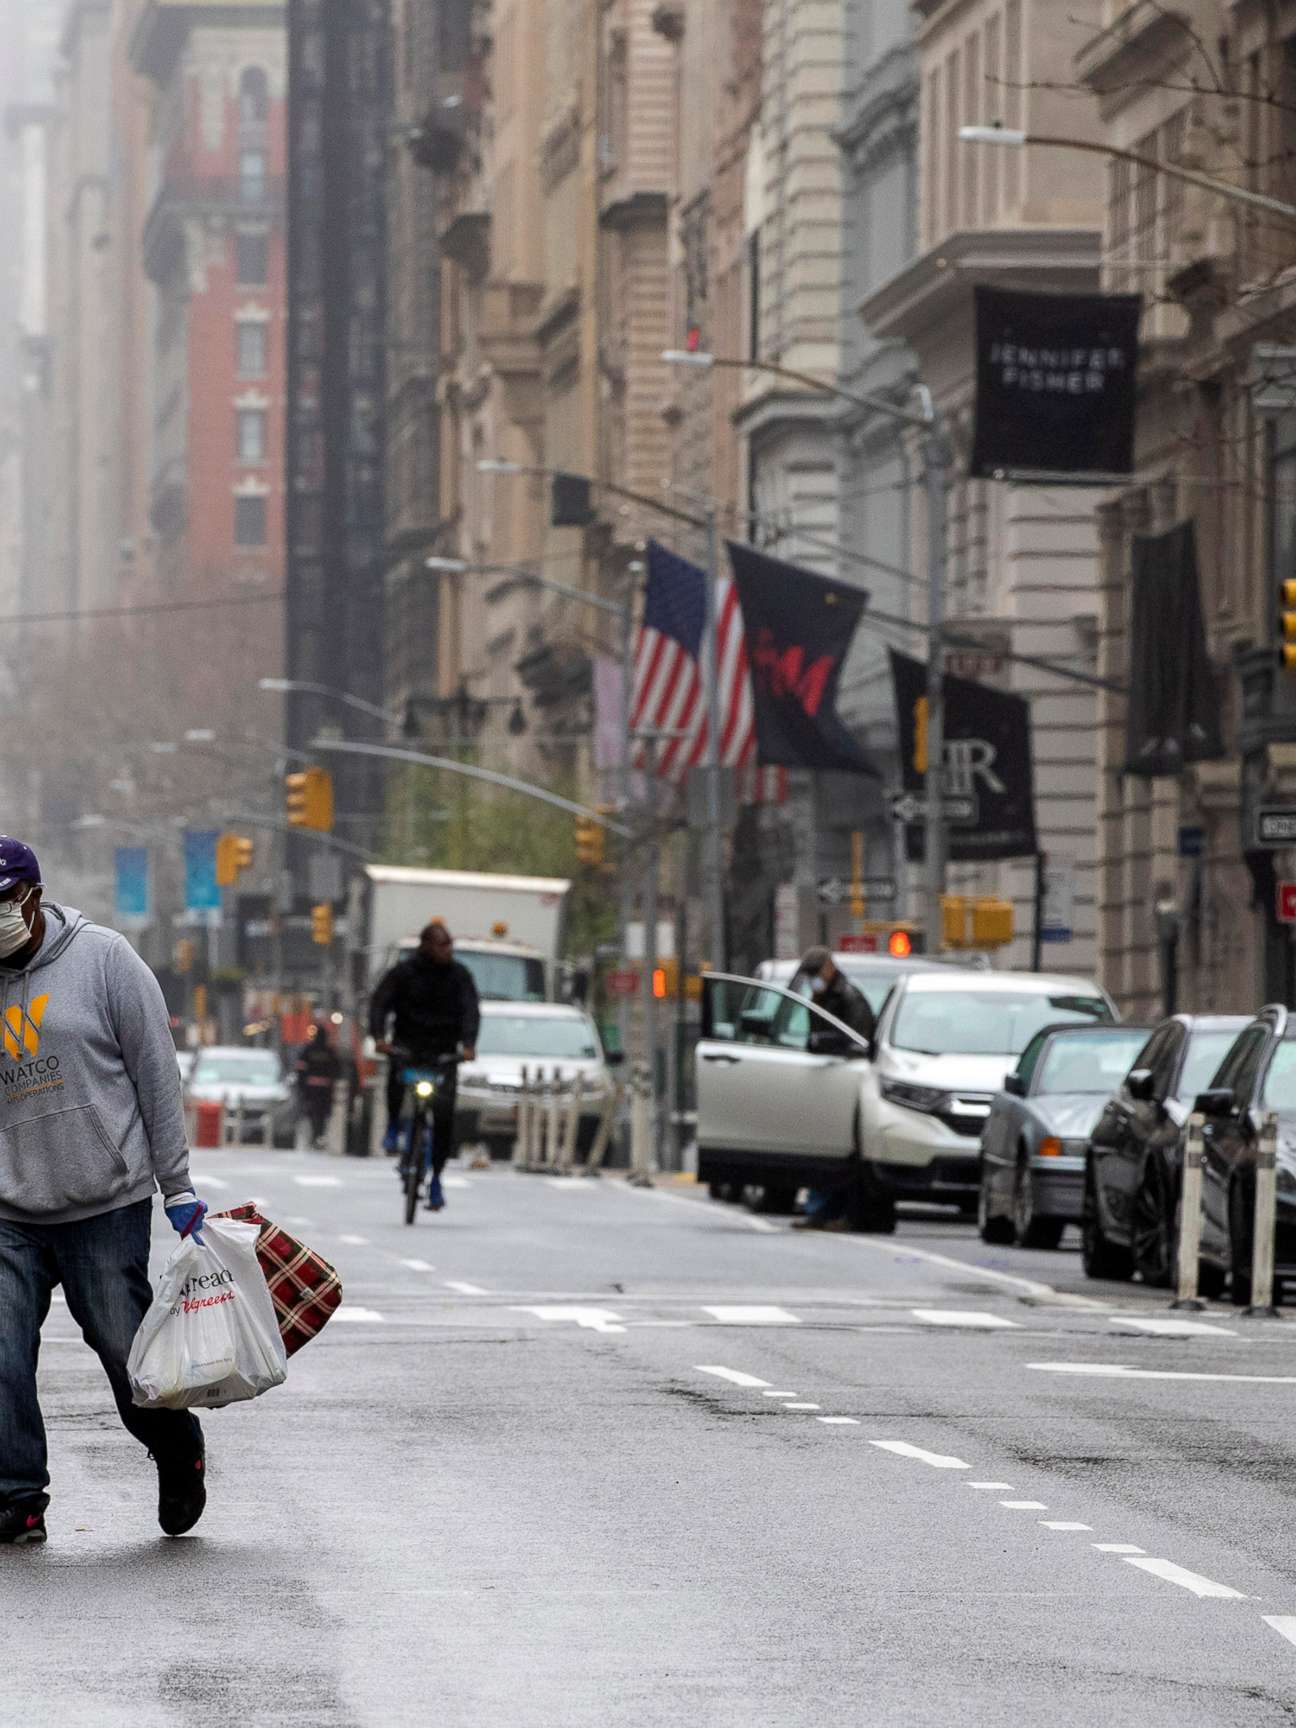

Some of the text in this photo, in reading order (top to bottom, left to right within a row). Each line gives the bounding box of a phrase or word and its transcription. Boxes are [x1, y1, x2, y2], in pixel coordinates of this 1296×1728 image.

[1003, 366, 1104, 394] FISHER
[0, 1055, 60, 1085] WATCO
[5, 1071, 63, 1097] COMPANIES
